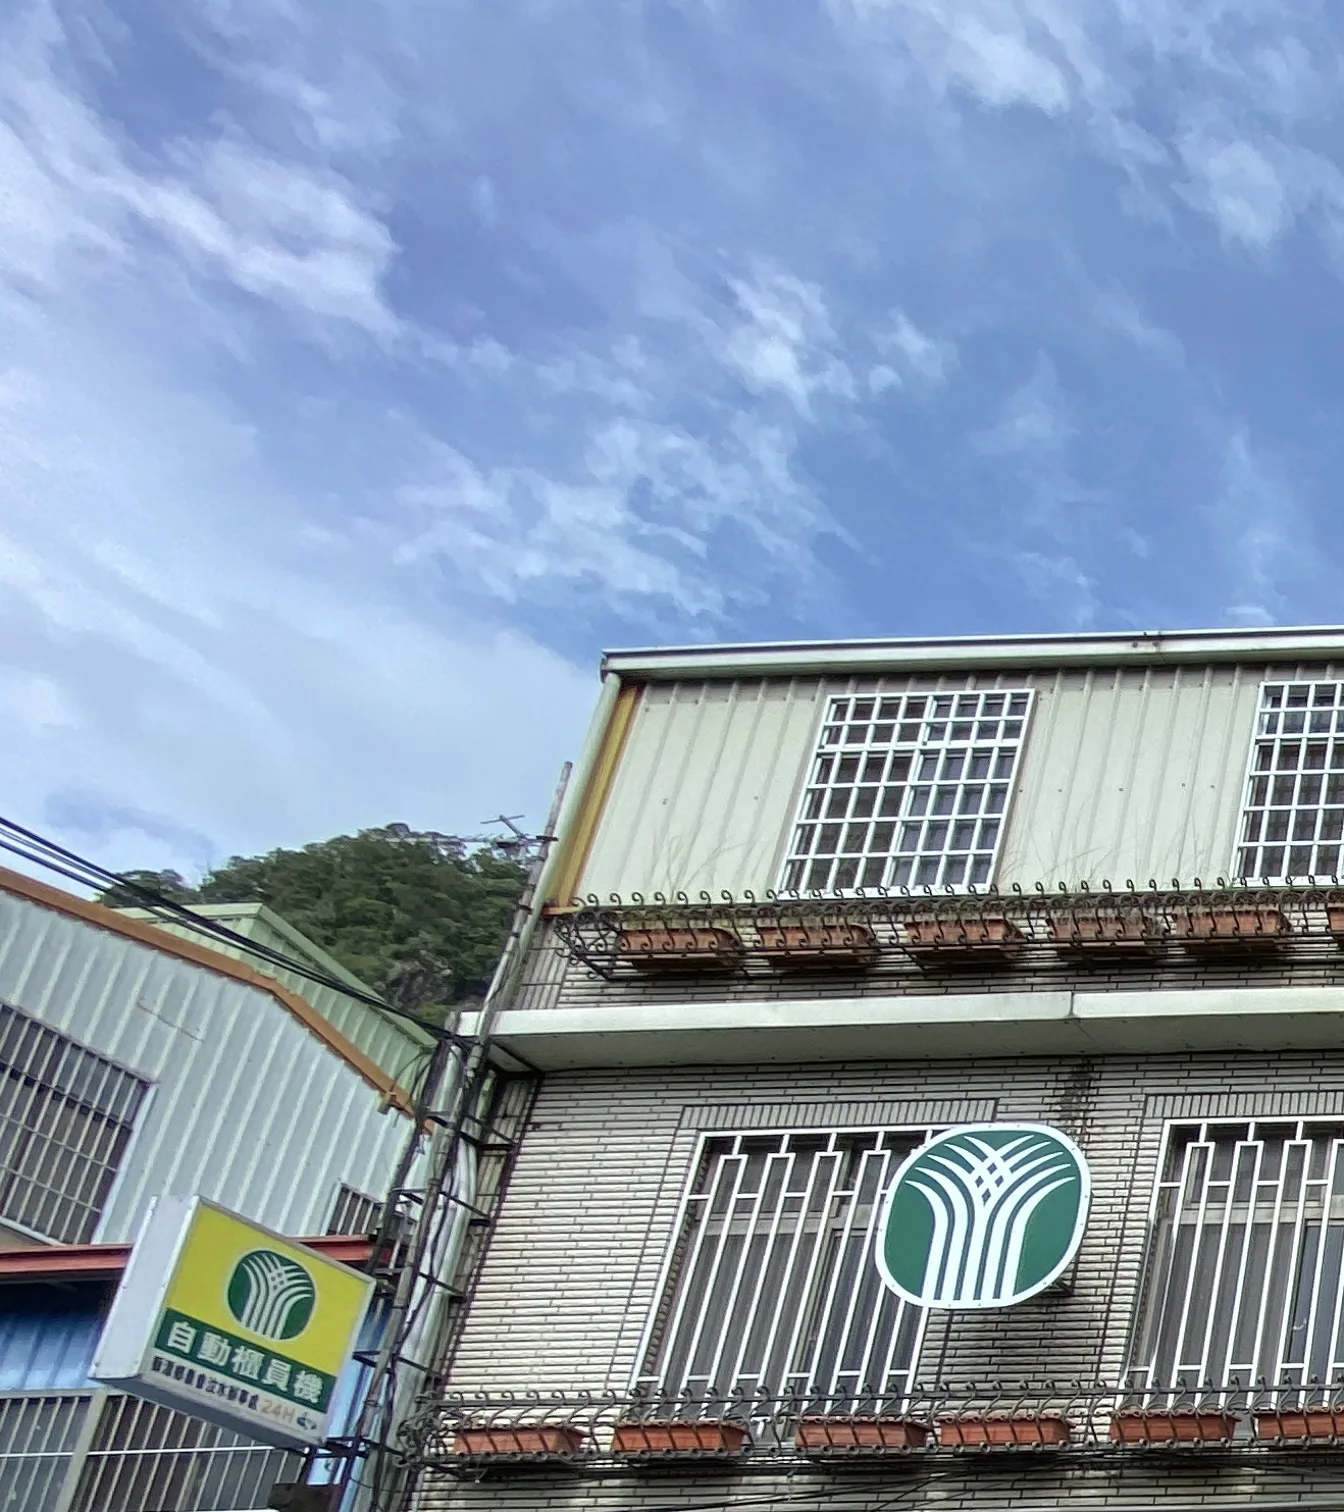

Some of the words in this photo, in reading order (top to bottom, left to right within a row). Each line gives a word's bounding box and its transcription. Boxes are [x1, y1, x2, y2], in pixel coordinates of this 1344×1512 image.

[166, 1320, 326, 1404] 自動櫃員機
[260, 1400, 295, 1423] 24H
